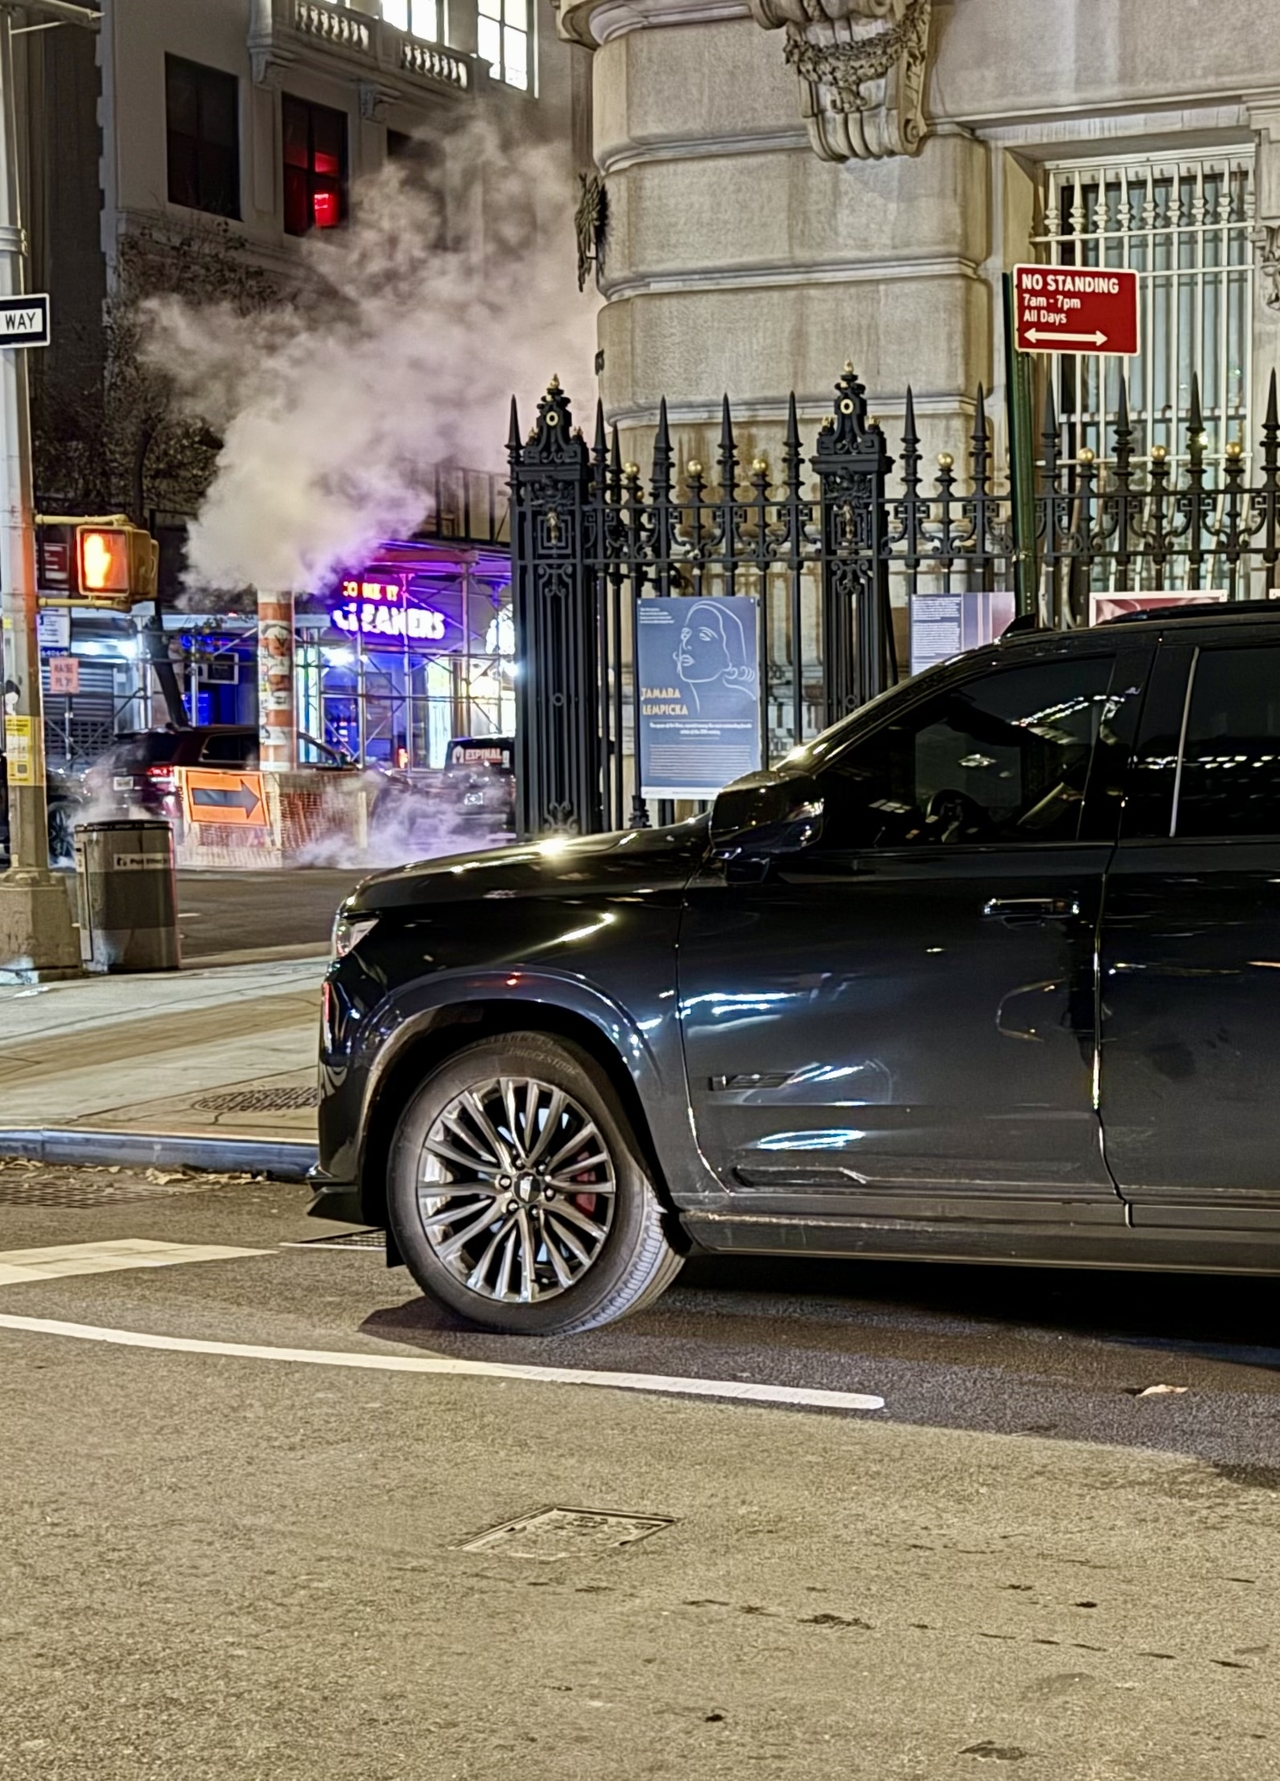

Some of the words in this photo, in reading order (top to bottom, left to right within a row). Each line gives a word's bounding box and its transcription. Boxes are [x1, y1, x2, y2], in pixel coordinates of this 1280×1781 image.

[1022, 273, 1043, 290] NO
[1046, 274, 1119, 294] STANDING
[1023, 293, 1047, 307] 7am
[1056, 295, 1081, 311] 7pm
[5, 311, 36, 331] WAY
[1023, 309, 1038, 322] All
[1040, 310, 1067, 326] Days
[641, 687, 681, 701] TAMARA
[642, 704, 689, 716] LEMPICKA
